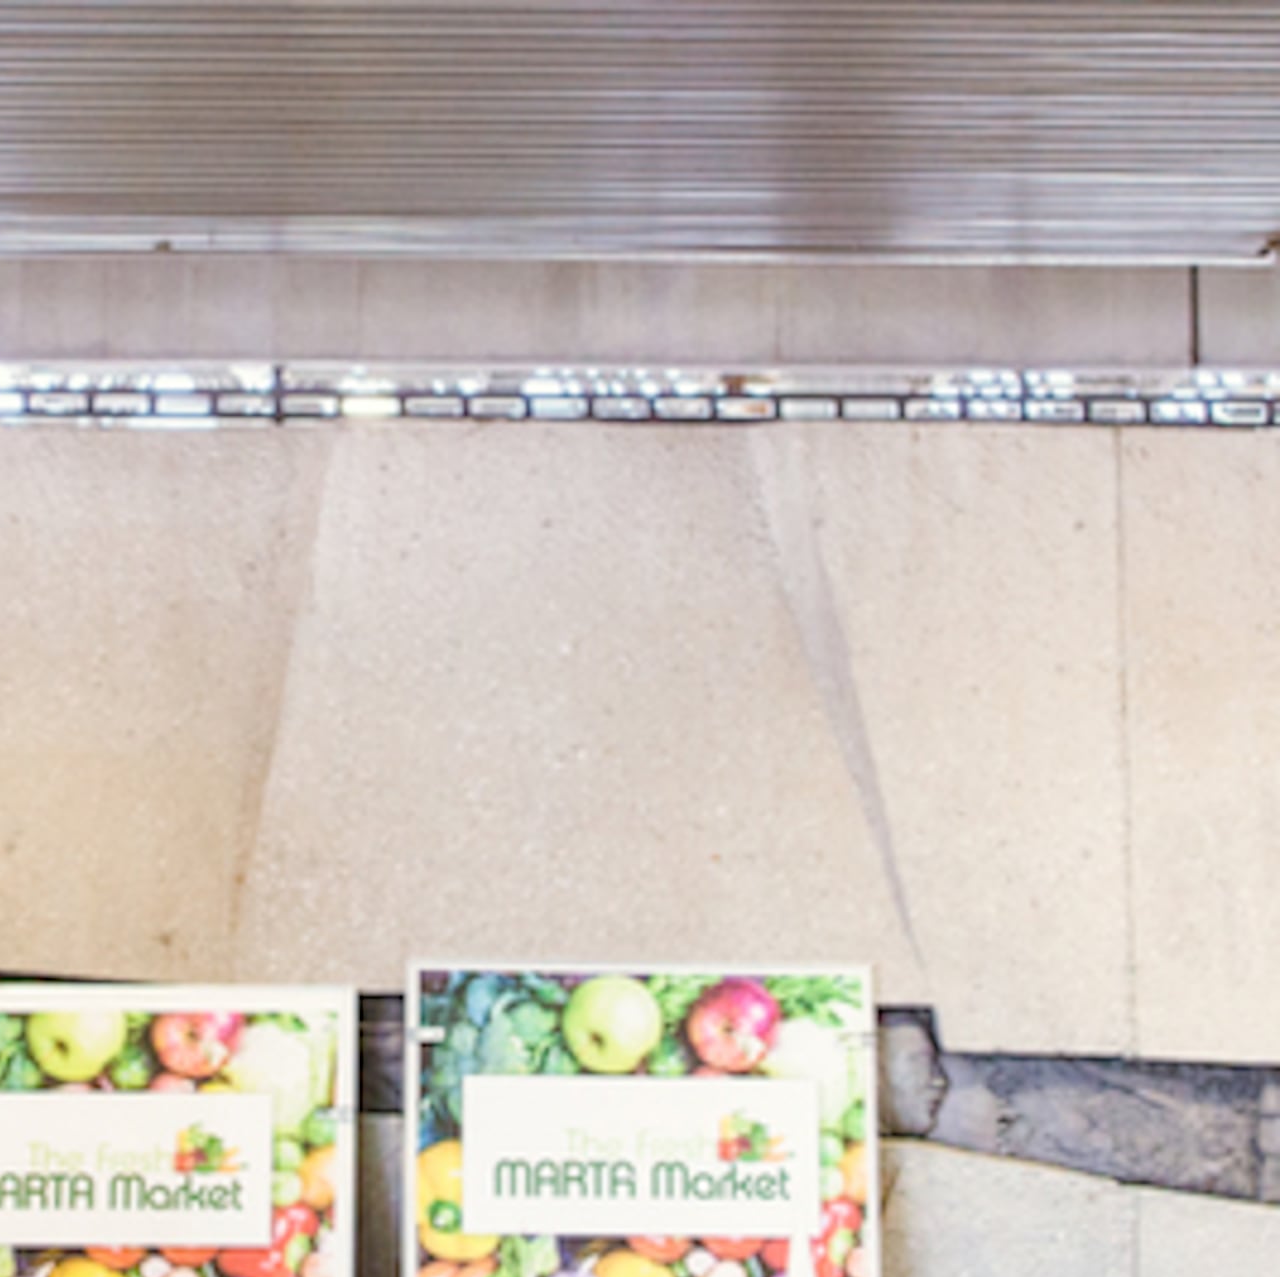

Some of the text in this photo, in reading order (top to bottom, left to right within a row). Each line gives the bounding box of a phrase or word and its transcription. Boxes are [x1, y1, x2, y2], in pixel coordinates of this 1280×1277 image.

[27, 1140, 86, 1170] The
[565, 1128, 624, 1158] The
[107, 1171, 244, 1211] Market
[493, 1159, 791, 1200] MARTA Market
